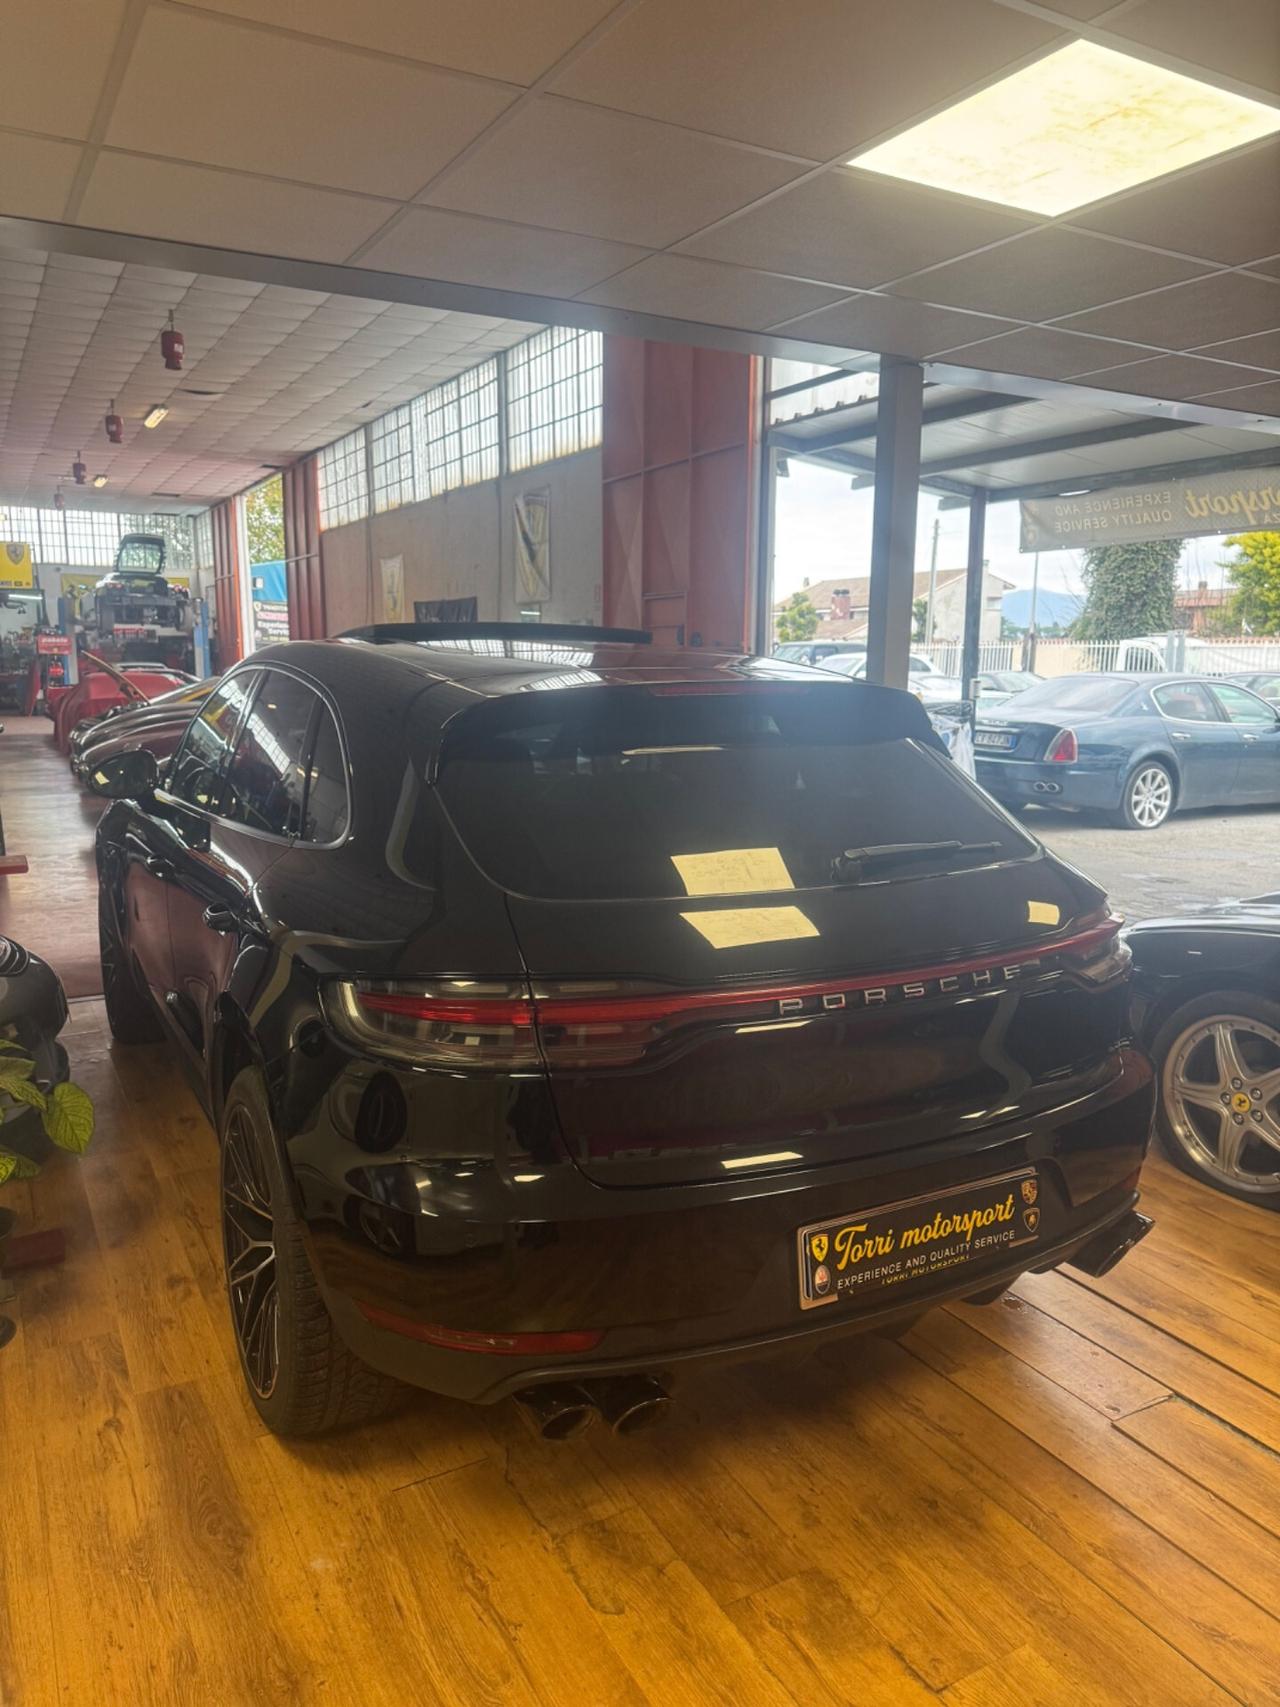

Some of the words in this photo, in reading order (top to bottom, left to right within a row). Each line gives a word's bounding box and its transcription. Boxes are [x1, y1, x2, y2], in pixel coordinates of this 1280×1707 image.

[779, 965, 1021, 1015] PORSCHE
[835, 1224, 896, 1271] Torri
[900, 1195, 1015, 1242] motorsport
[837, 1262, 902, 1290] EXPERIENCE
[905, 1254, 926, 1270] AND
[929, 1241, 971, 1262] QUALITY
[974, 1229, 1016, 1249] SERVICE
